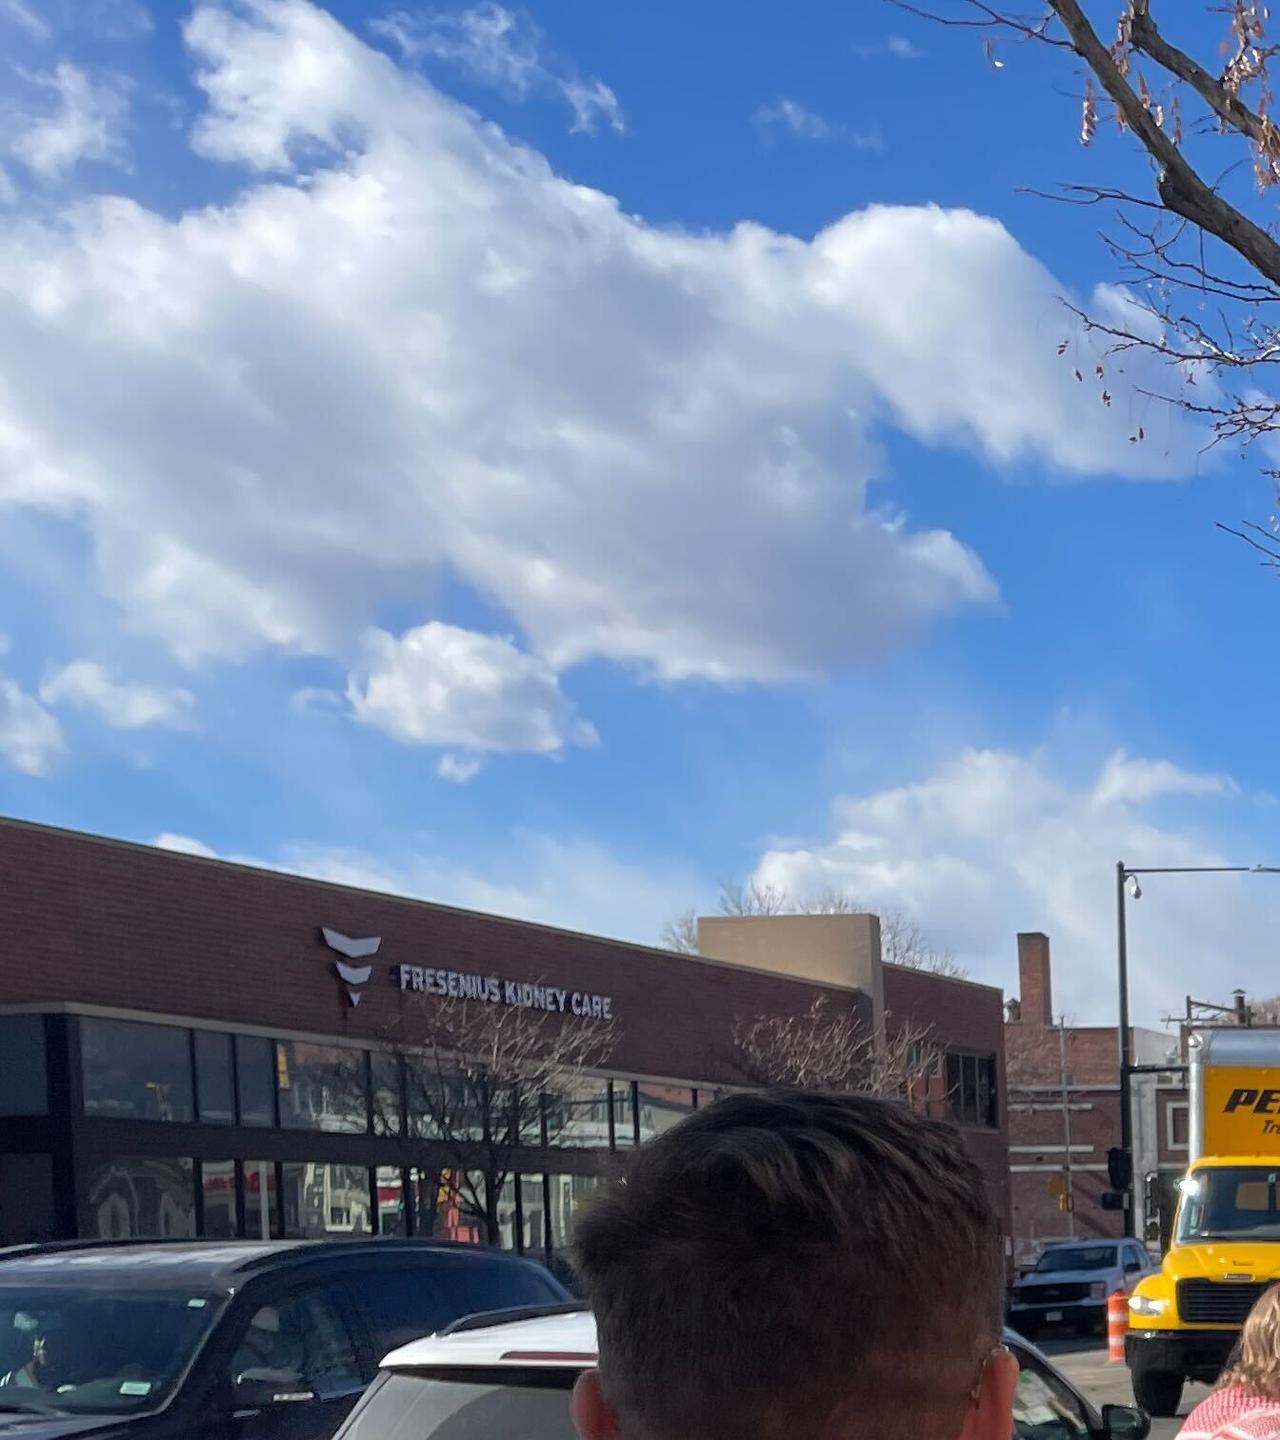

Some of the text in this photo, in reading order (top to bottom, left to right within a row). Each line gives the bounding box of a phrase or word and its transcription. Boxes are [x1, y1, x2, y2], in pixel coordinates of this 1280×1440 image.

[400, 964, 613, 1020] FRESENIUS KIDNEY CARE
